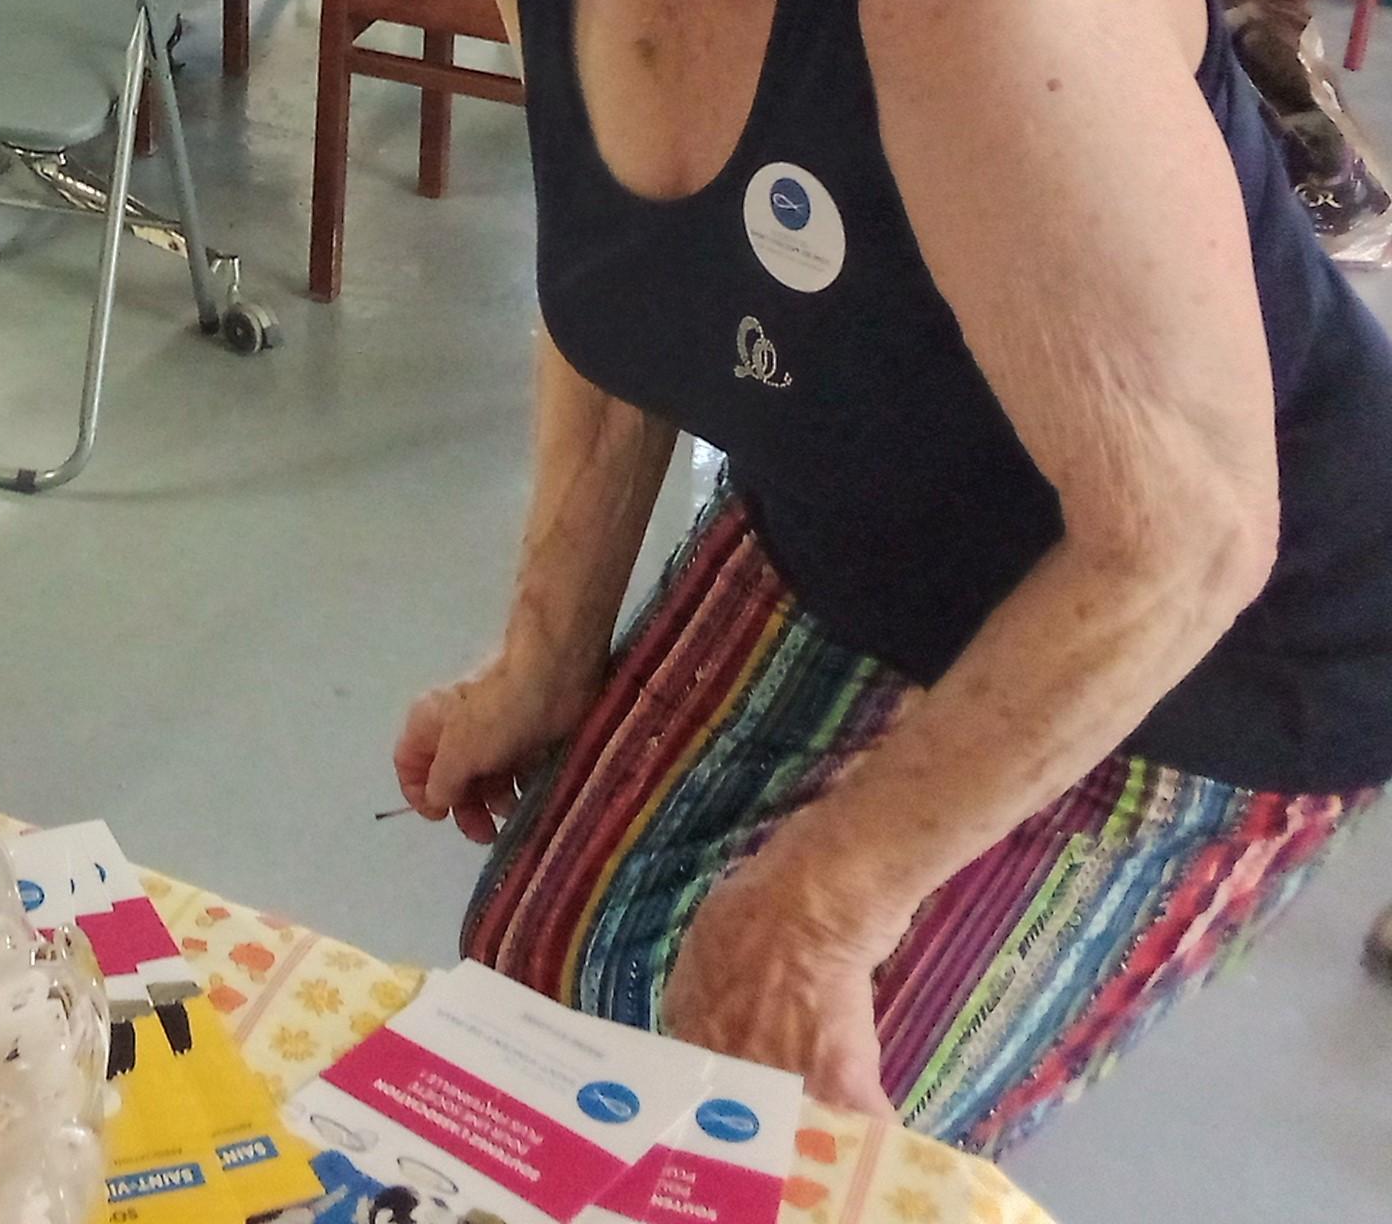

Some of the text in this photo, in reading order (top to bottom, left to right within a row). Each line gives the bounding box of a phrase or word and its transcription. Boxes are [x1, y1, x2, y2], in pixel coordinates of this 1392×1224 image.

[220, 1141, 267, 1166] SAIN
[107, 1167, 194, 1198] SAINT-VI
[109, 1207, 140, 1223] SO
